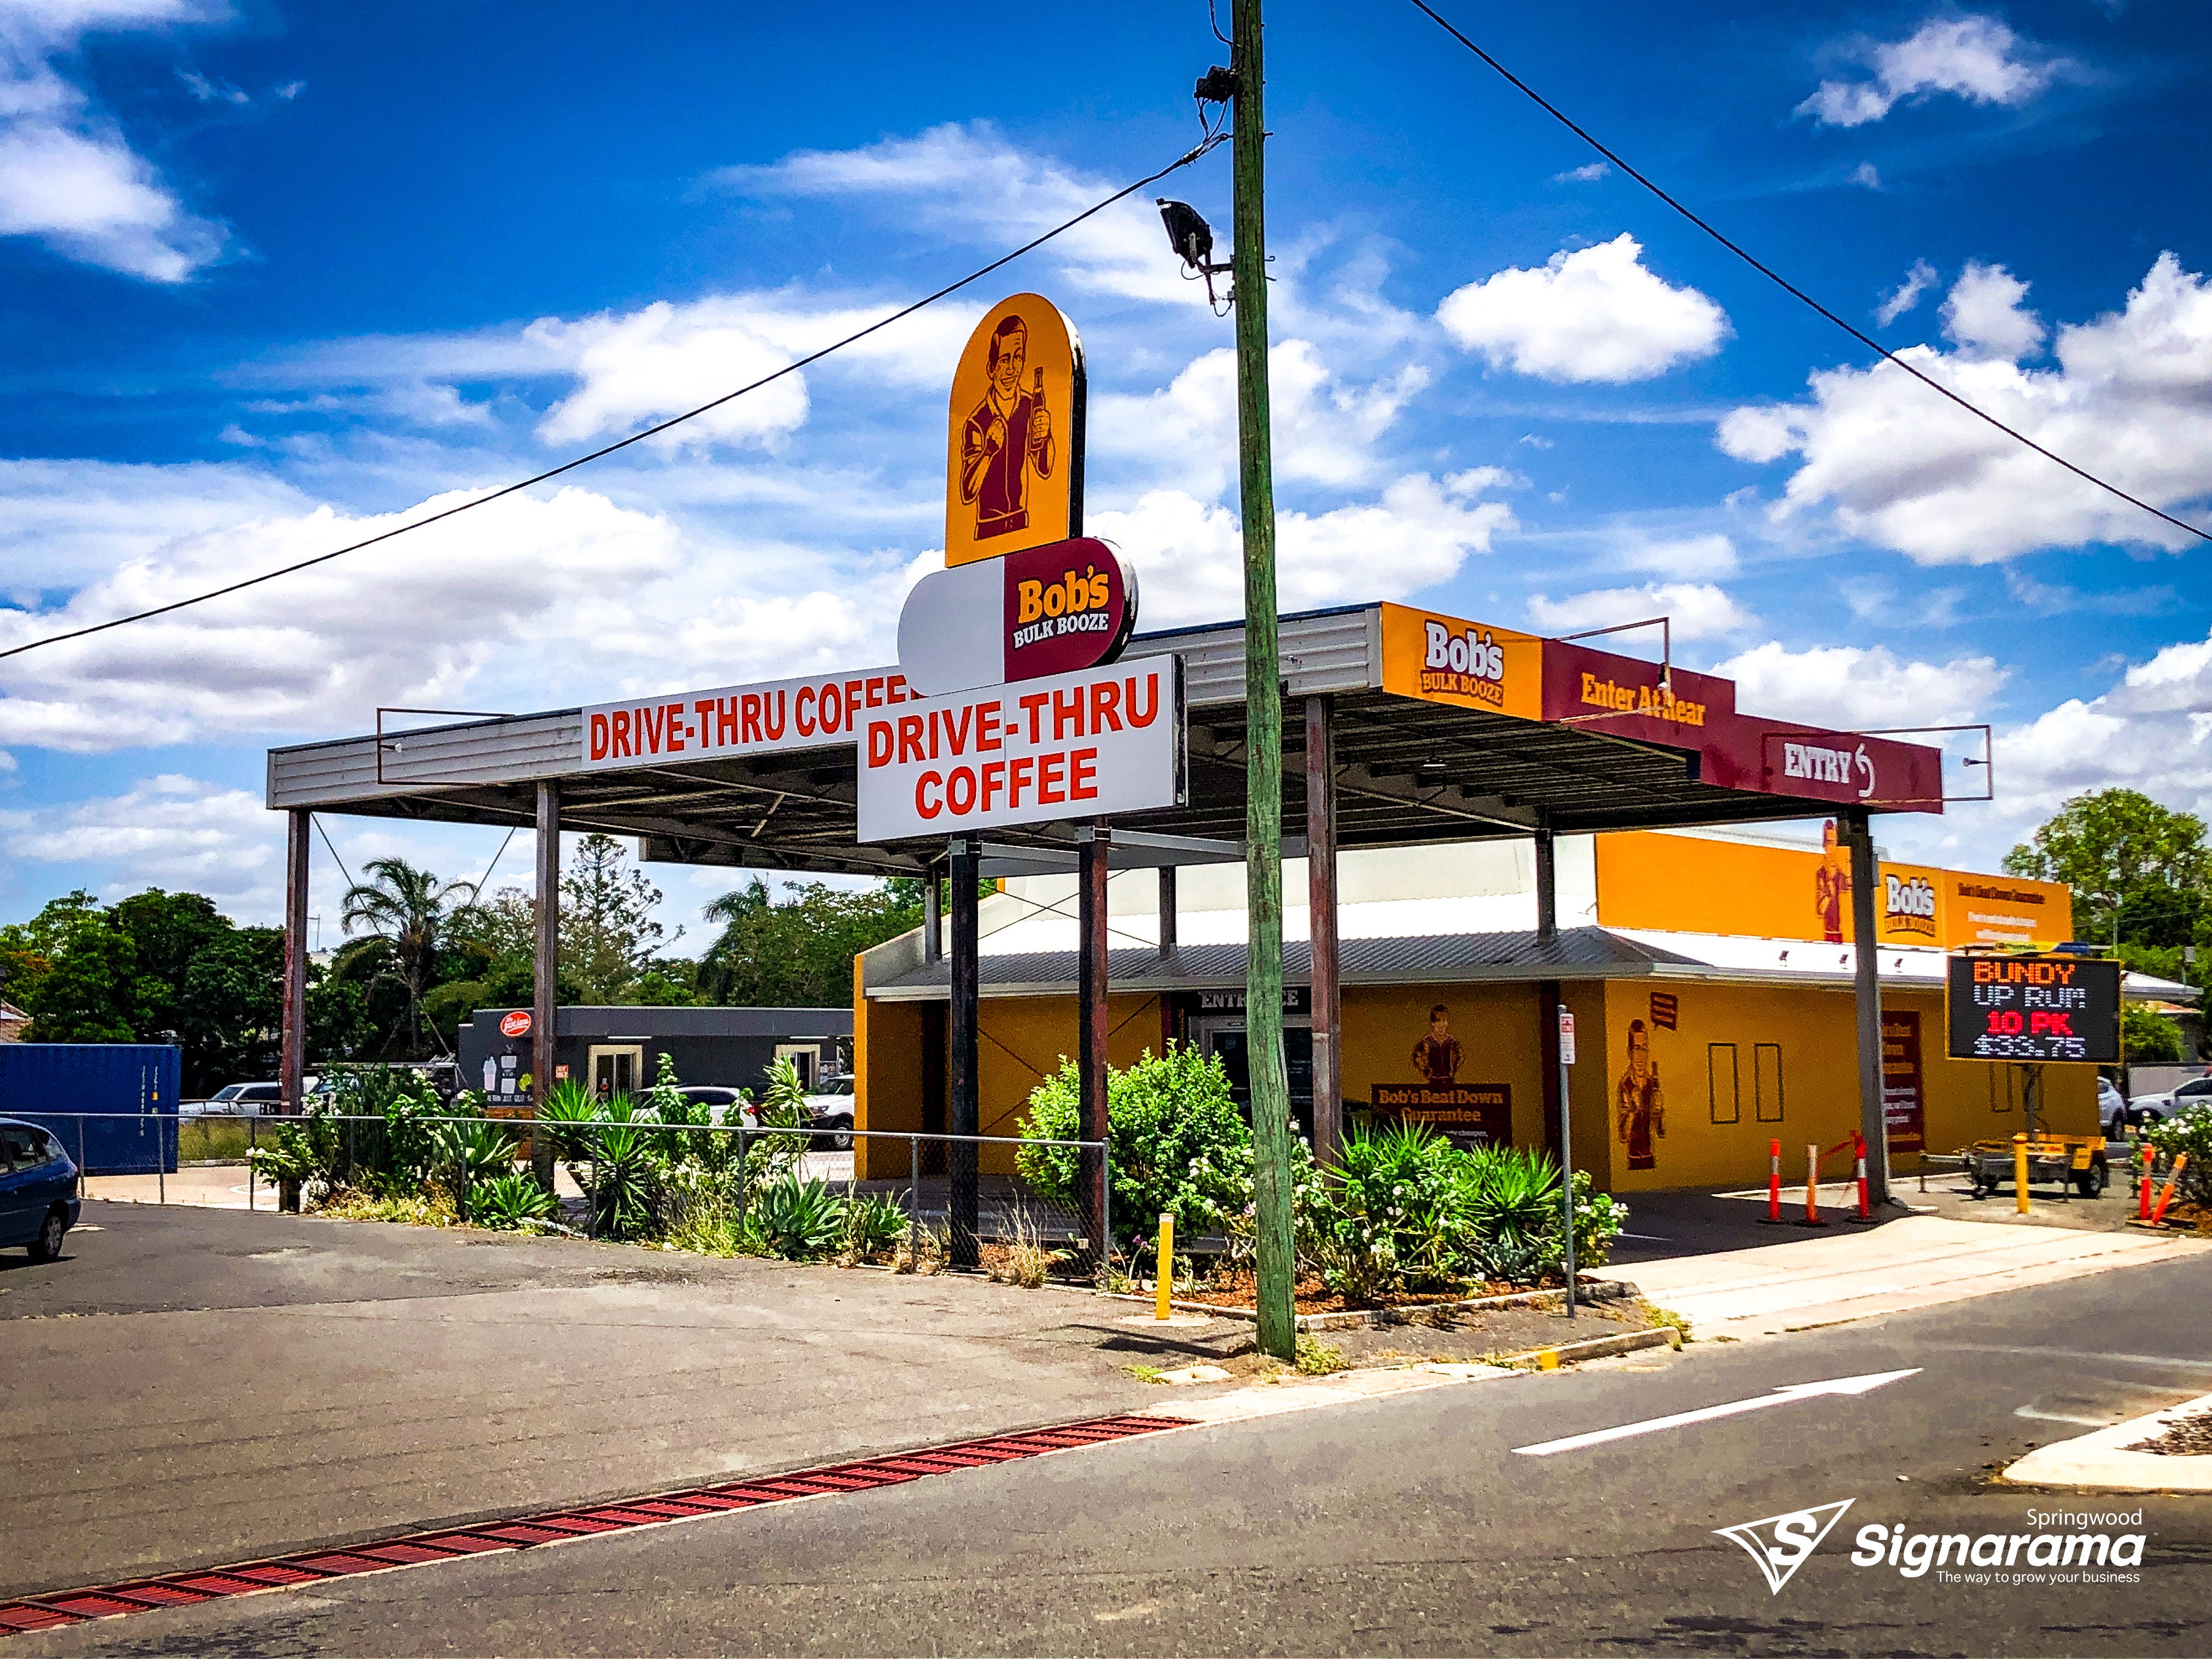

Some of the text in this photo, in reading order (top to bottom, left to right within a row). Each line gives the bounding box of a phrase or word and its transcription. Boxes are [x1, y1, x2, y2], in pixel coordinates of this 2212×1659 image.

[1018, 565, 1109, 624] Bob's
[1014, 613, 1109, 649] BULK BOOZE
[1425, 622, 1503, 680] Bob's
[1422, 673, 1503, 704] BULK BOOZE
[1581, 672, 1707, 726] Enter At Rear
[590, 674, 929, 761] DRIVE-THRU COFFE
[868, 673, 1159, 769] DRIVE-THRU
[915, 747, 1098, 820] COFFEE
[1784, 742, 1852, 784] ENTRY
[1886, 876, 1935, 916] Bob's
[1974, 961, 2076, 985] BUNDY
[1974, 985, 2015, 1007] UP
[1987, 1010, 2074, 1036] 10 PK
[1378, 1090, 1419, 1104] Bob's
[1456, 1090, 1503, 1104] Down
